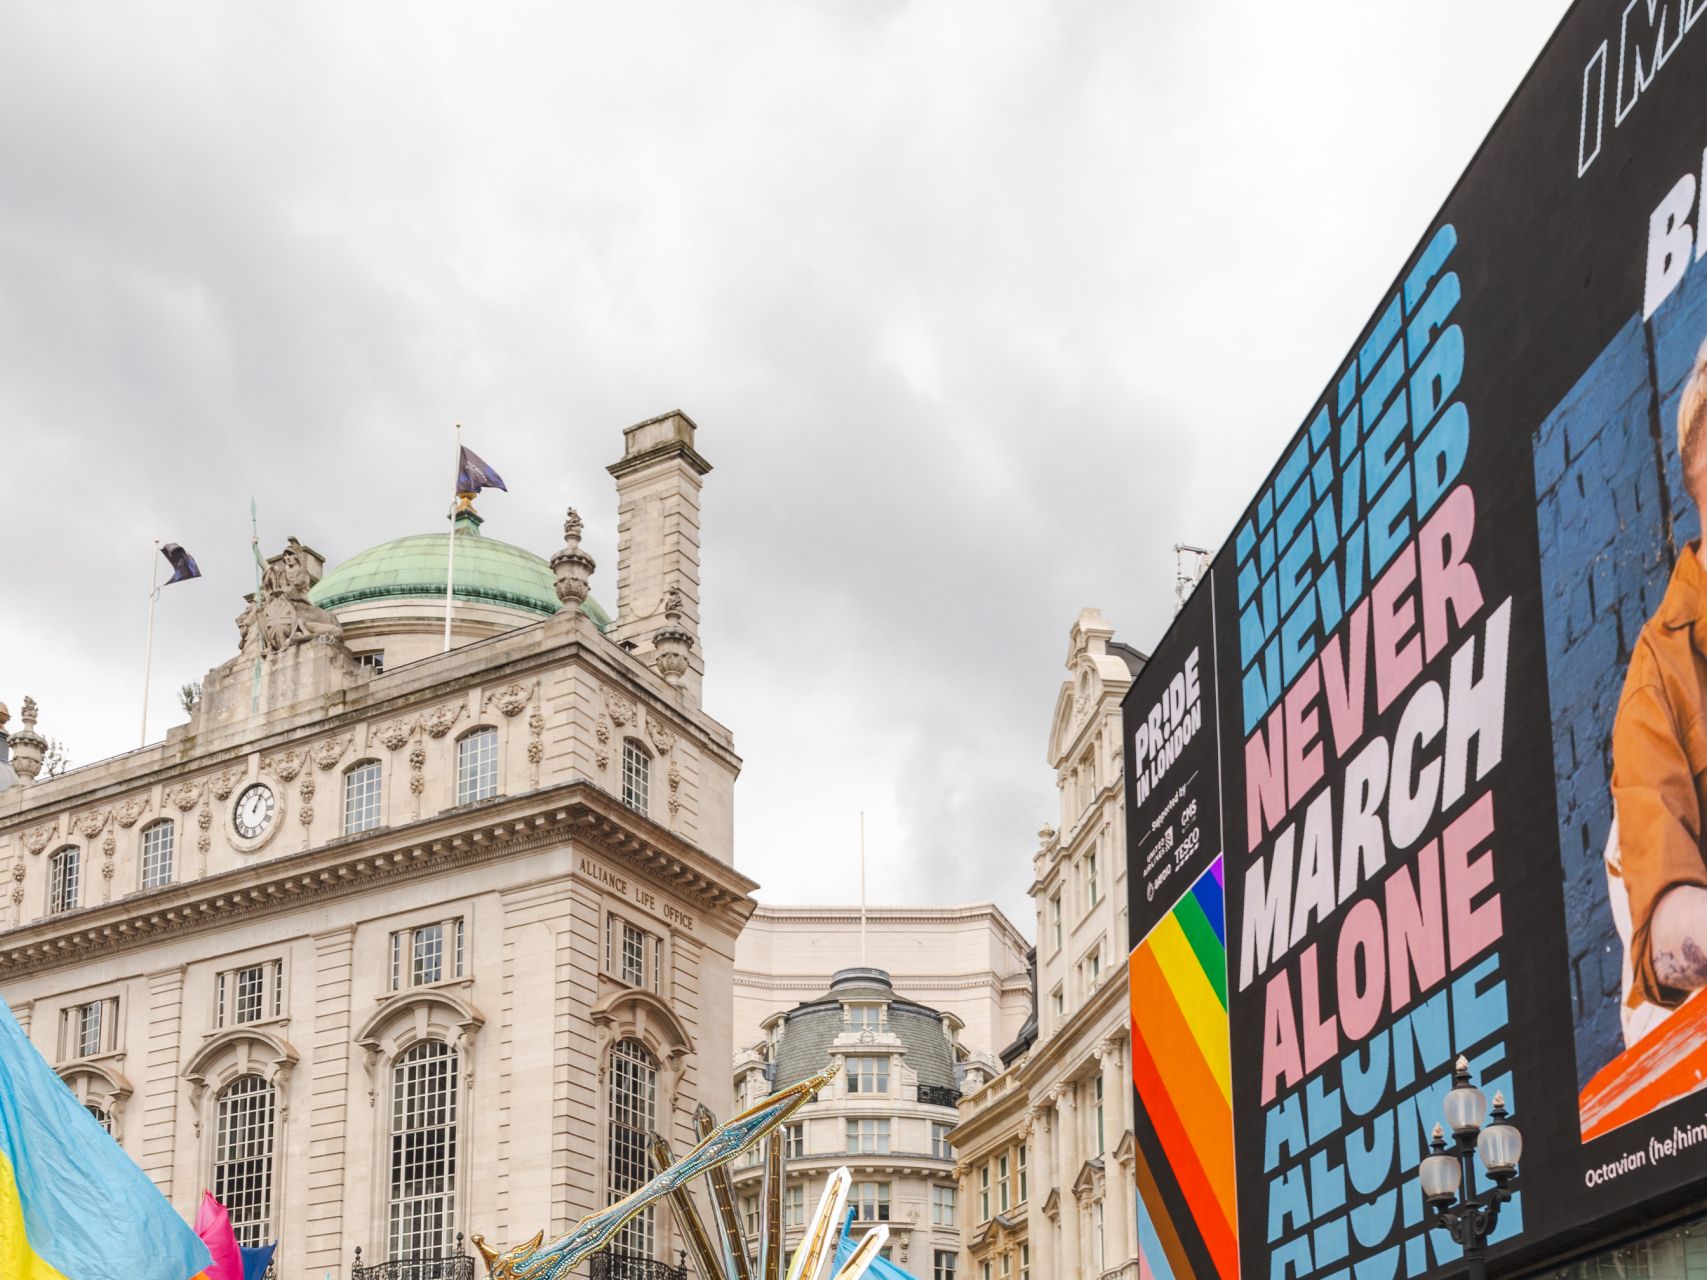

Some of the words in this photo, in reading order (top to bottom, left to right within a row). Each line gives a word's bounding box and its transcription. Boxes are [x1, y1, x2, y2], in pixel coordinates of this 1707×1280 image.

[1642, 147, 1707, 322] B
[1245, 484, 1484, 854] NEVER
[1136, 775, 1151, 808] IN
[1150, 699, 1201, 789] LONDON
[1239, 595, 1512, 992] MARCH
[579, 858, 627, 895] ALLIANCE
[635, 888, 655, 910] LIFE
[663, 903, 693, 931] OFFICE
[1174, 827, 1200, 864] TESCO
[1261, 790, 1504, 1107] ALONE
[1585, 1151, 1646, 1188] Octavian
[1649, 1112, 1707, 1166] (he/him
